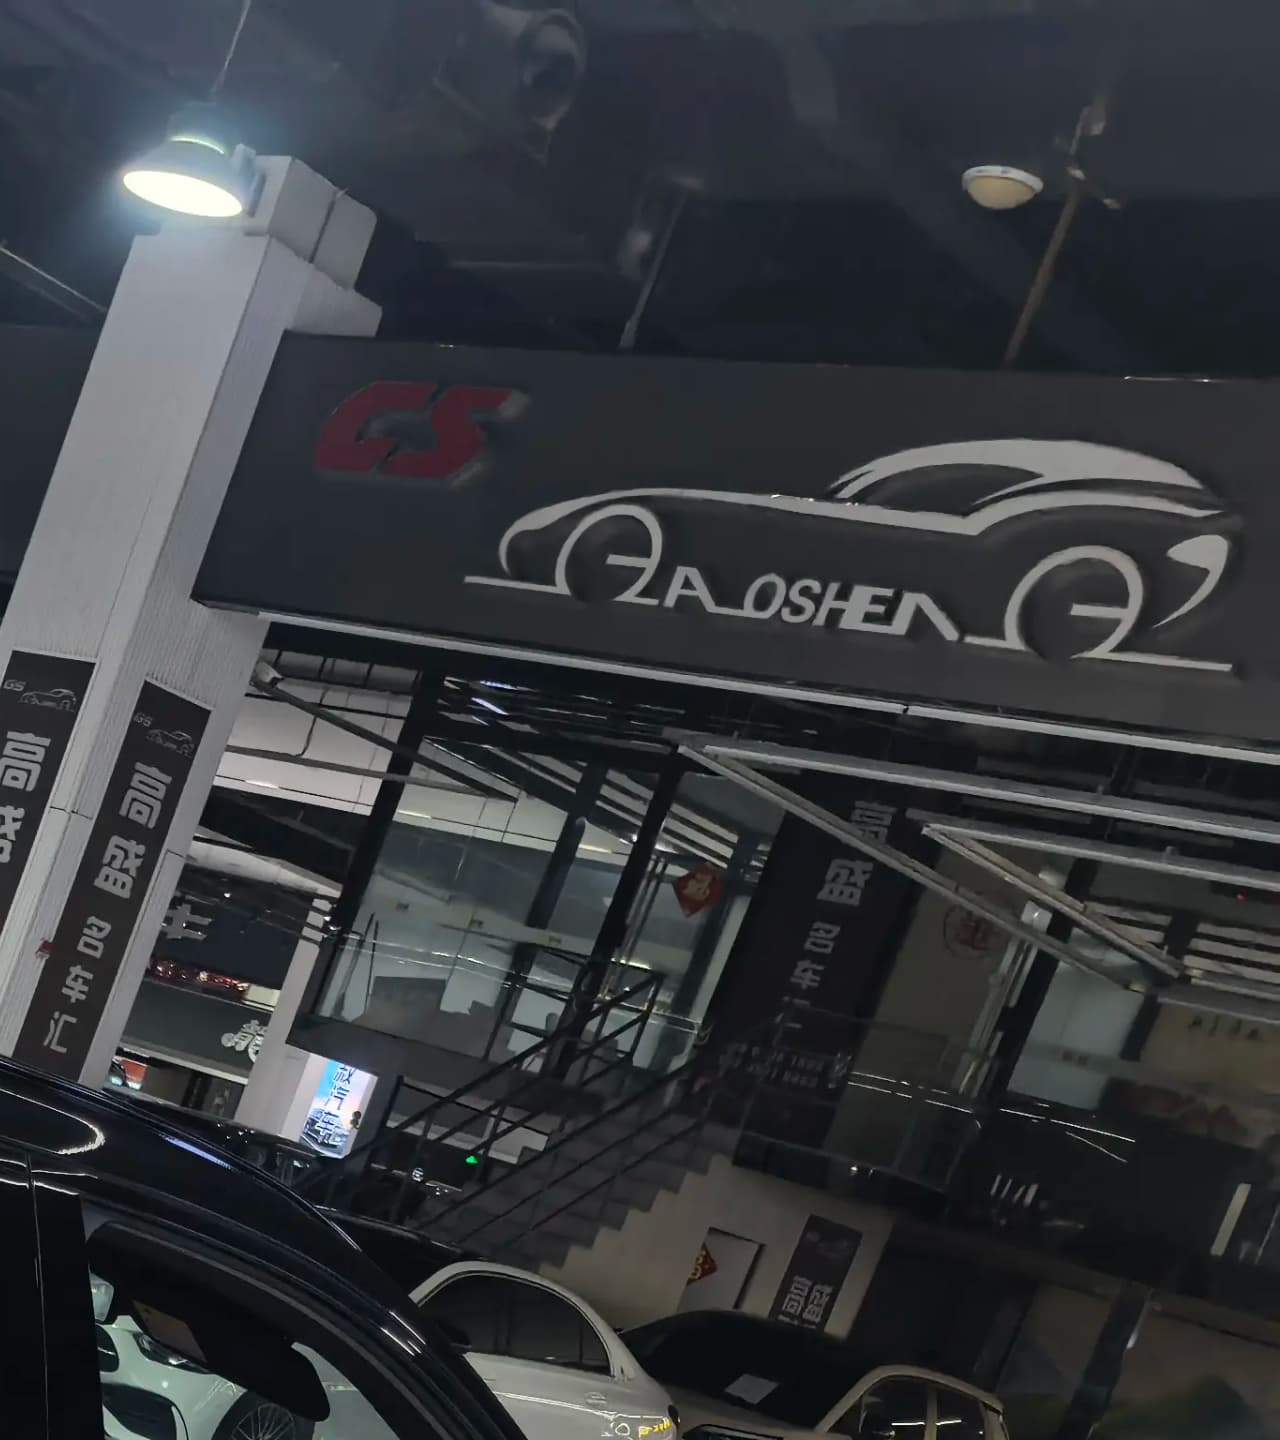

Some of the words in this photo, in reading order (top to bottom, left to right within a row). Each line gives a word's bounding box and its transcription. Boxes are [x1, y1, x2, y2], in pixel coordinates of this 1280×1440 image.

[314, 379, 528, 482] GS
[43, 761, 173, 1054] 高盛名车汇
